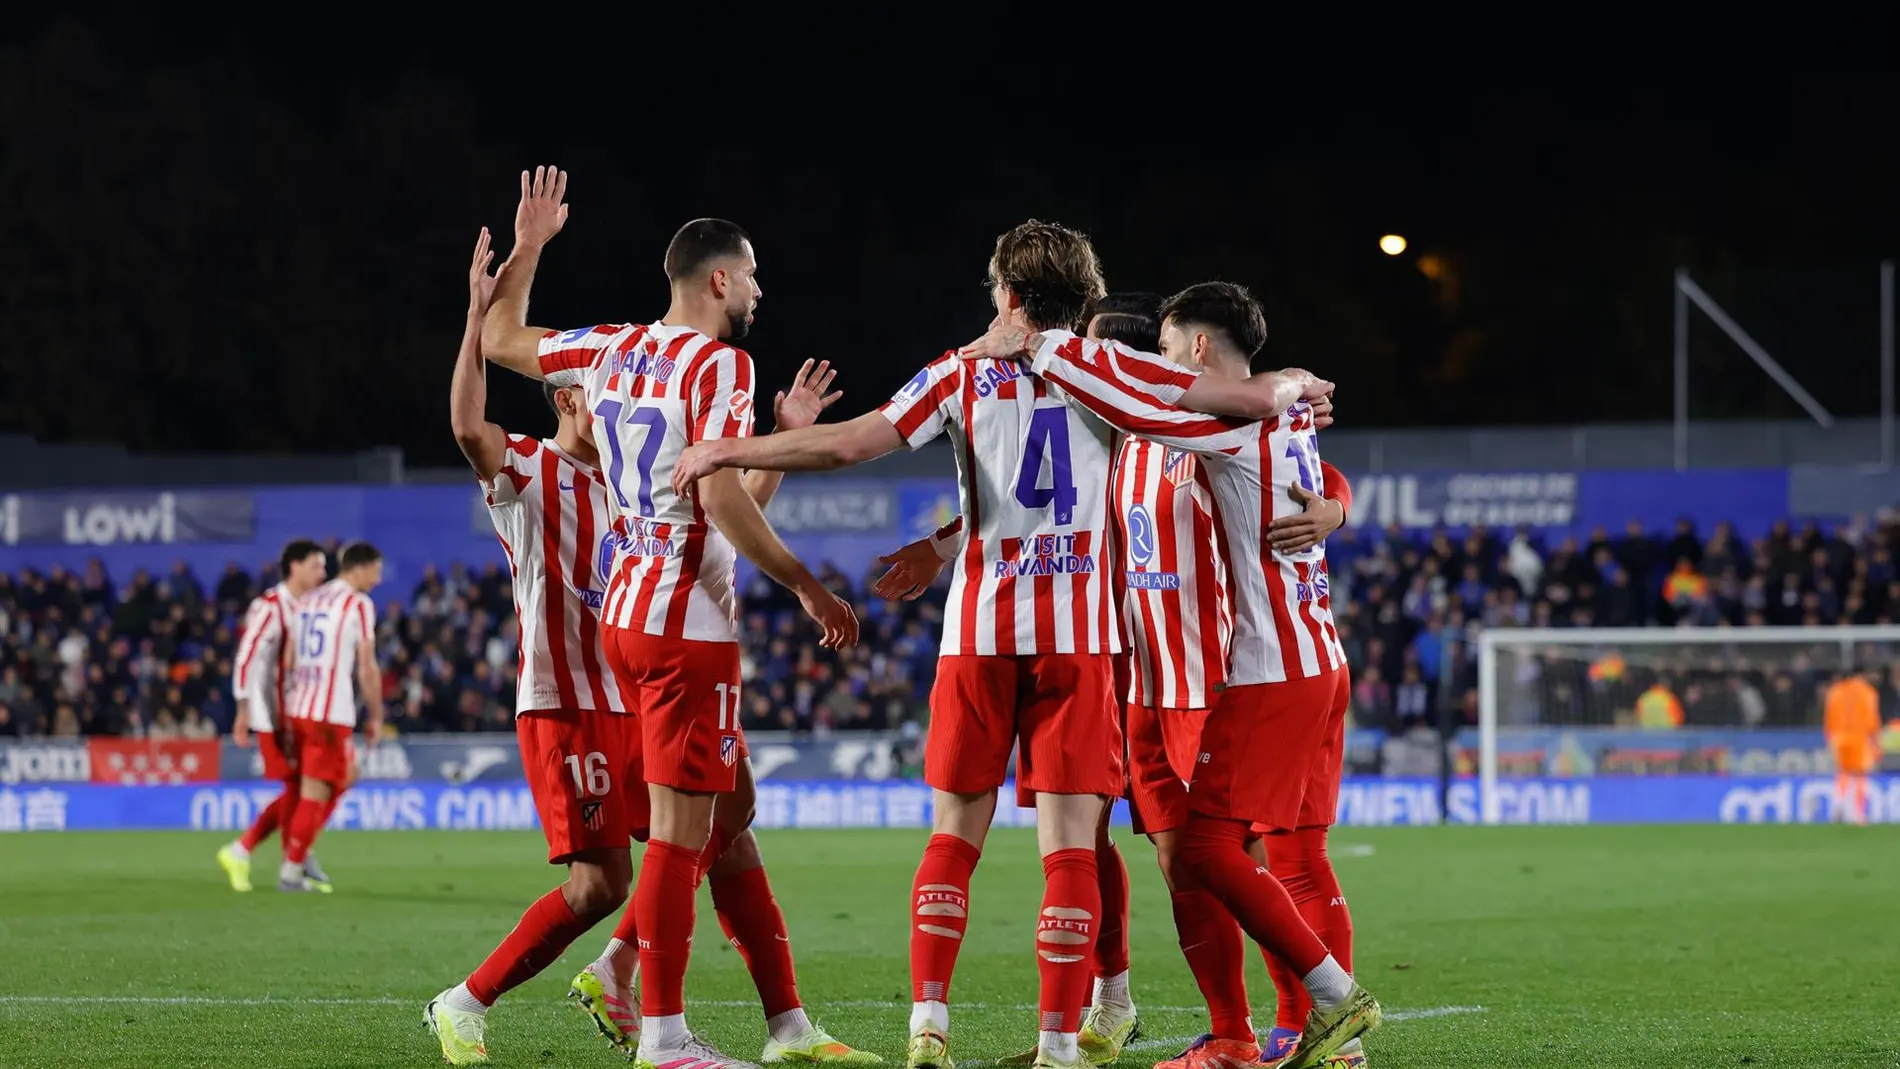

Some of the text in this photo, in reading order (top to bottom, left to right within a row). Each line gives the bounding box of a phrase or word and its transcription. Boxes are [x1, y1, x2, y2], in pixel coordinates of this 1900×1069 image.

[594, 398, 667, 518] 17
[1015, 407, 1077, 525] 4
[1019, 535, 1075, 555] VISIT
[994, 555, 1095, 578] RWANDA
[1153, 574, 1177, 588] AIR
[300, 612, 329, 658] 15
[564, 751, 611, 799] 16
[917, 893, 966, 909] ATLETI
[1037, 919, 1089, 934] ATLETI
